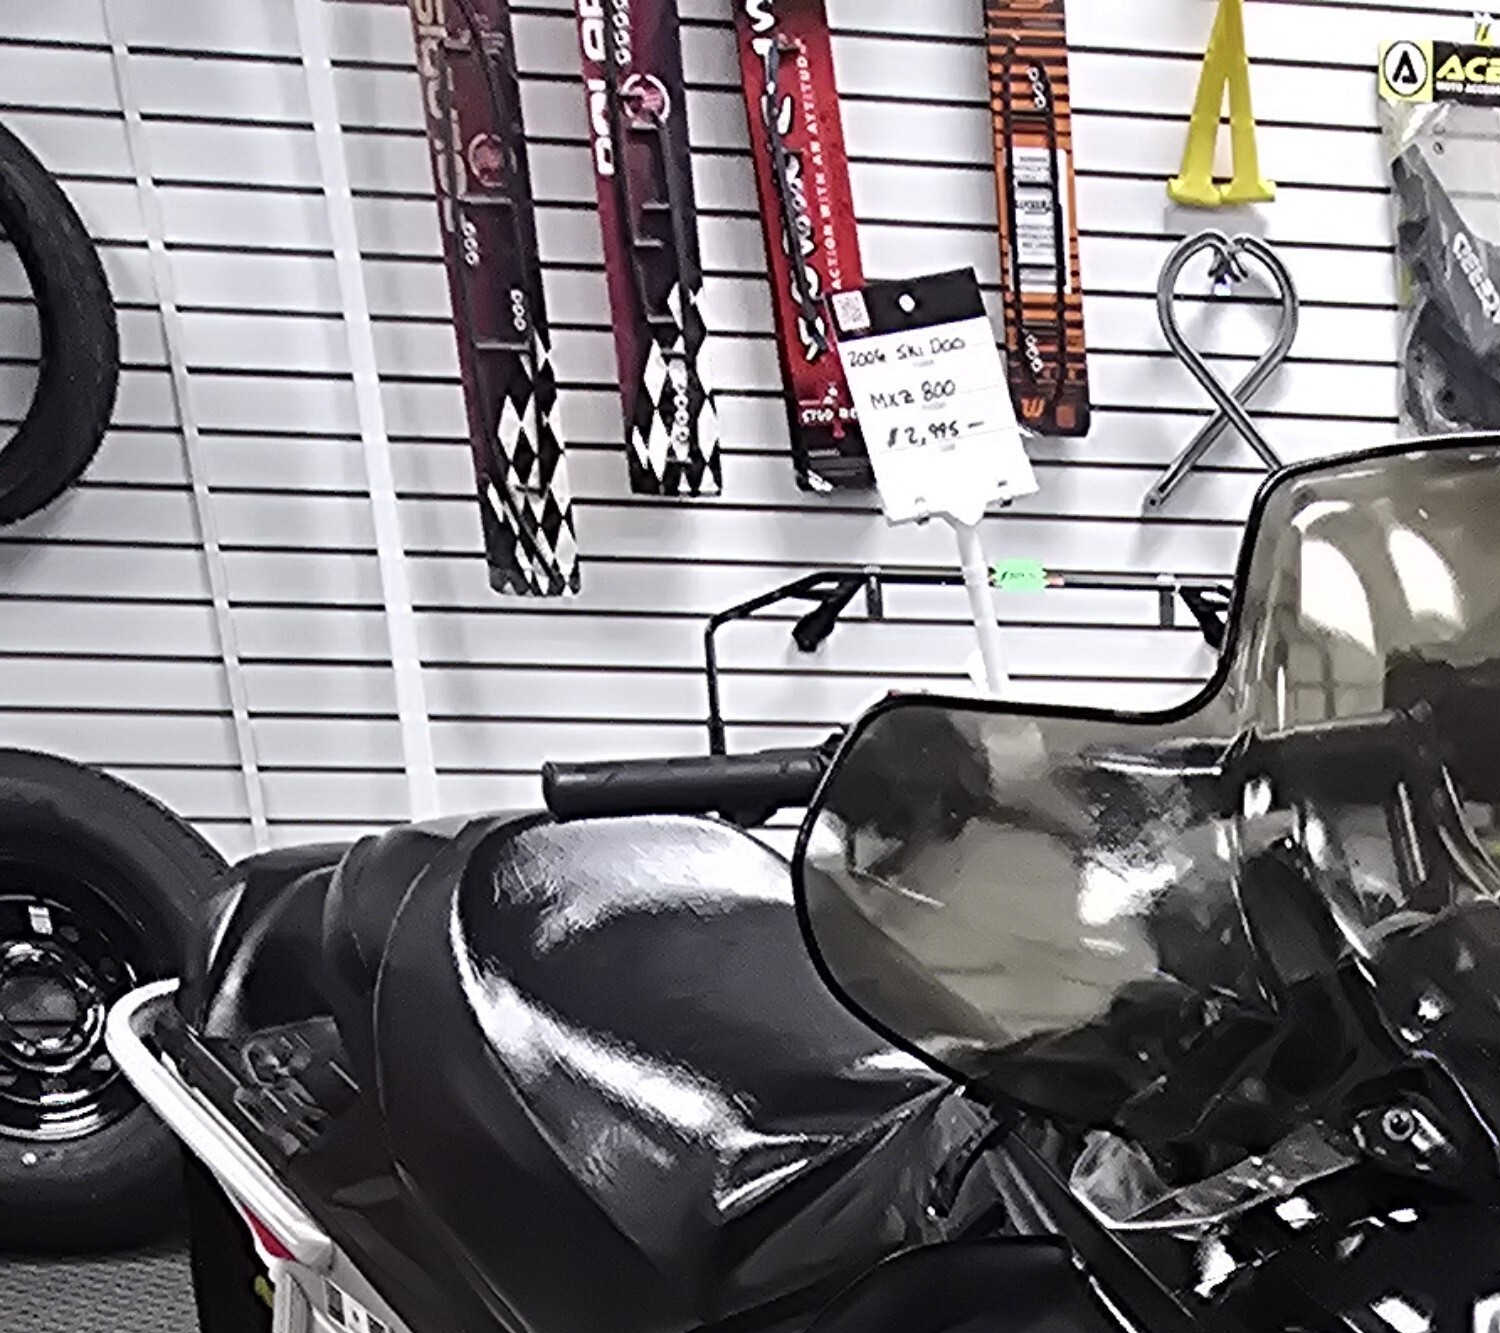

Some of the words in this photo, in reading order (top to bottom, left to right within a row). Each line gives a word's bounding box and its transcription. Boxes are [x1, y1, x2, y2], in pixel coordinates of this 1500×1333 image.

[810, 140, 823, 166] AN
[815, 172, 832, 219] WITH
[929, 337, 966, 354] DOO
[869, 389, 915, 410] MXZ
[921, 379, 956, 402] 800
